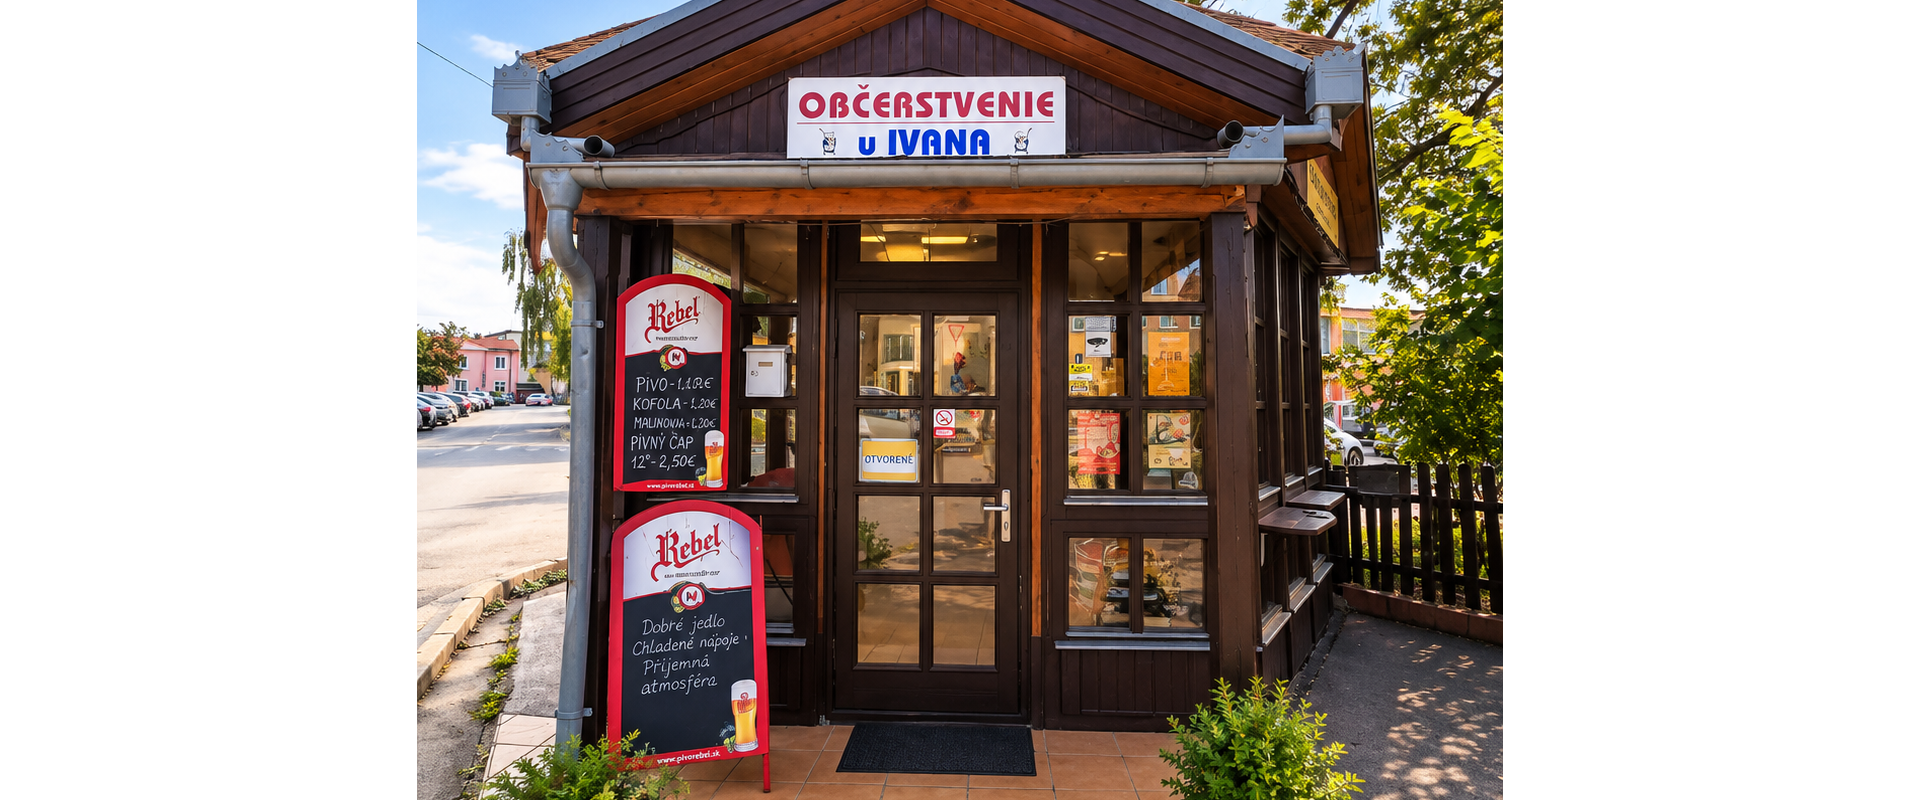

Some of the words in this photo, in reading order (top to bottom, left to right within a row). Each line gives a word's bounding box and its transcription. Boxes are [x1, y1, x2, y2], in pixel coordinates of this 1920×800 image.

[799, 84, 1054, 119] OBČERSTVENIE
[858, 136, 876, 156] u
[888, 129, 990, 156] IVANA
[644, 295, 701, 344] Rebel
[633, 397, 681, 411] KOFOLA
[669, 431, 694, 450] ČAP
[659, 454, 697, 471] 2,50€
[865, 452, 914, 464] OTVORENÉ
[651, 523, 722, 583] Rebel
[642, 617, 684, 636] Dobré
[688, 613, 726, 636] jedlo
[632, 636, 694, 656] Chladené
[641, 673, 718, 695] atmosféra
